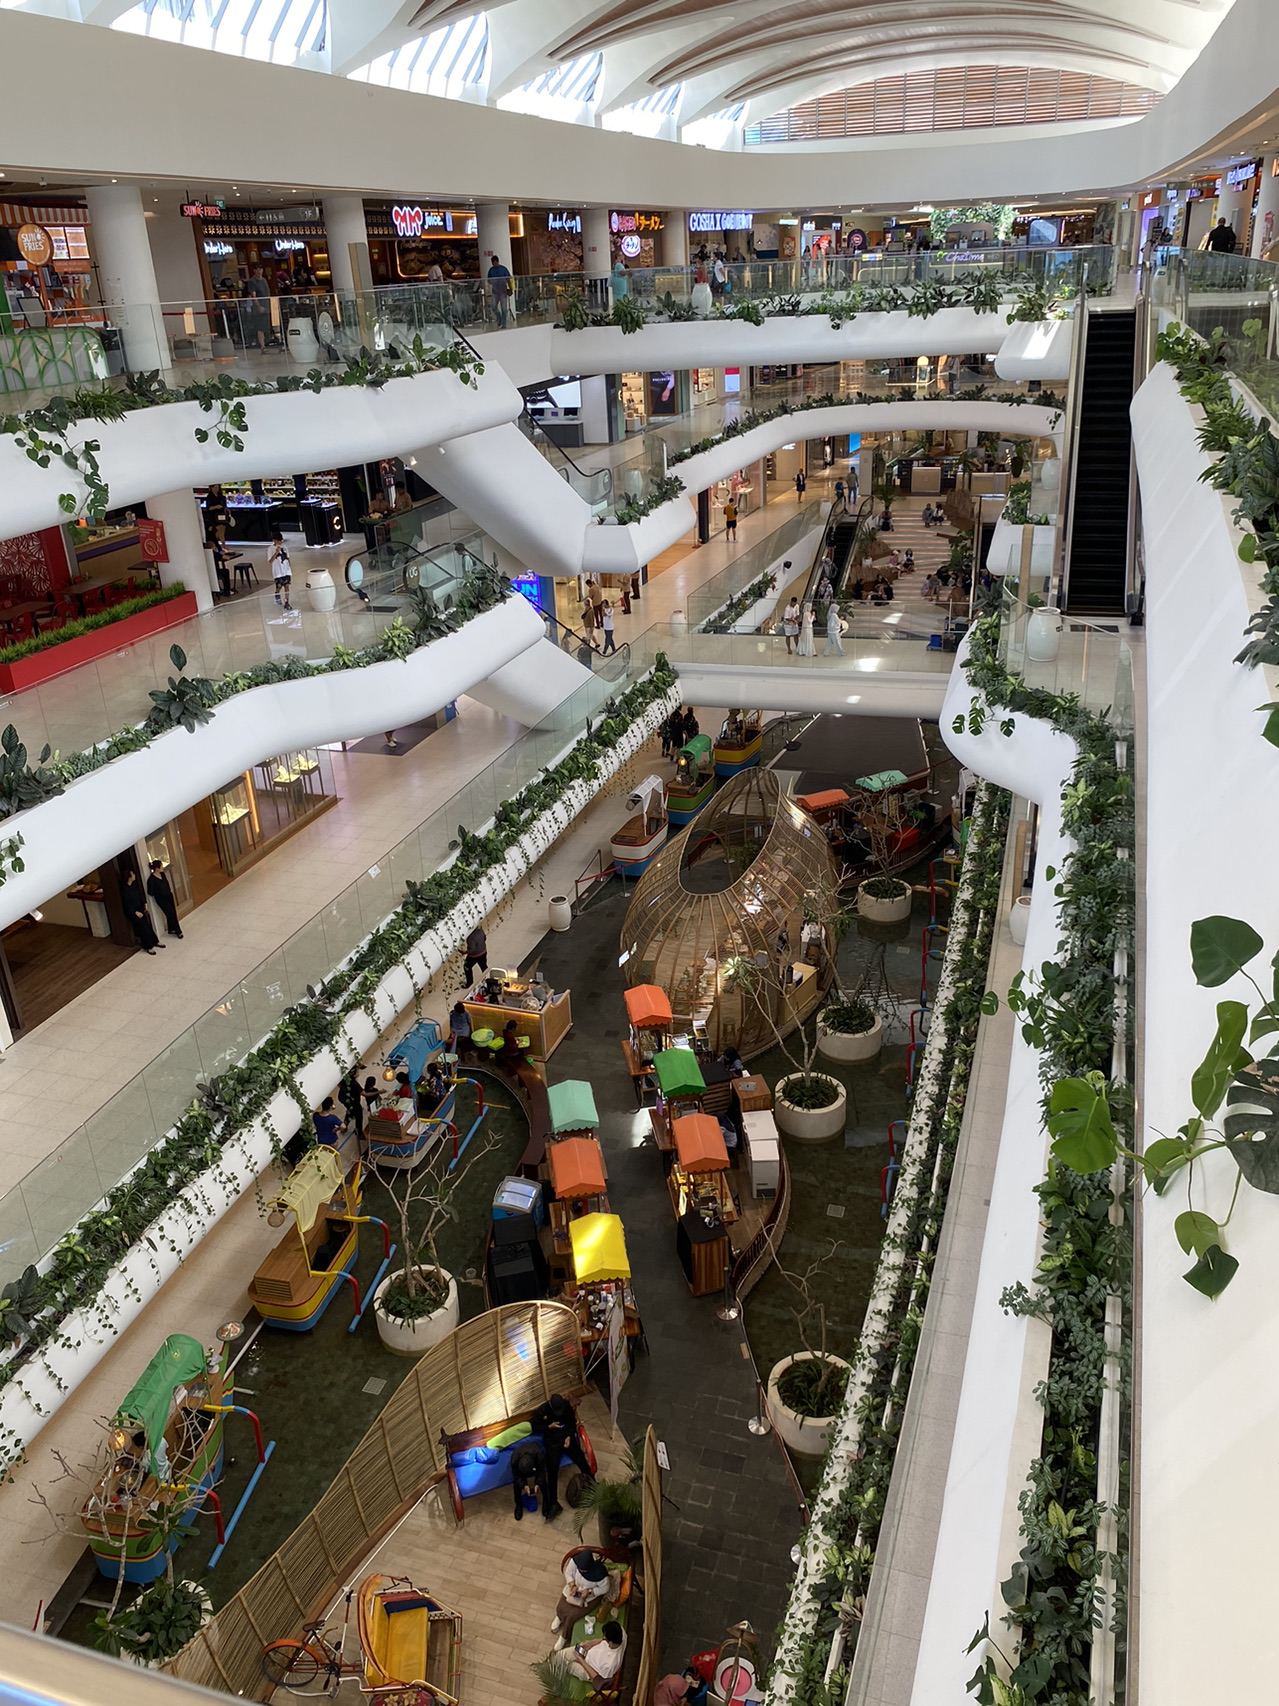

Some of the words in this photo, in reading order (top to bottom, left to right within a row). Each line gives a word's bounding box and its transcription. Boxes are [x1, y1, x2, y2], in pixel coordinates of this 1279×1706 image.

[183, 205, 197, 216] SUN
[204, 205, 221, 217] FRIES
[689, 213, 715, 232] GOSHA
[21, 232, 37, 242] SUN
[23, 241, 44, 251] FRIES
